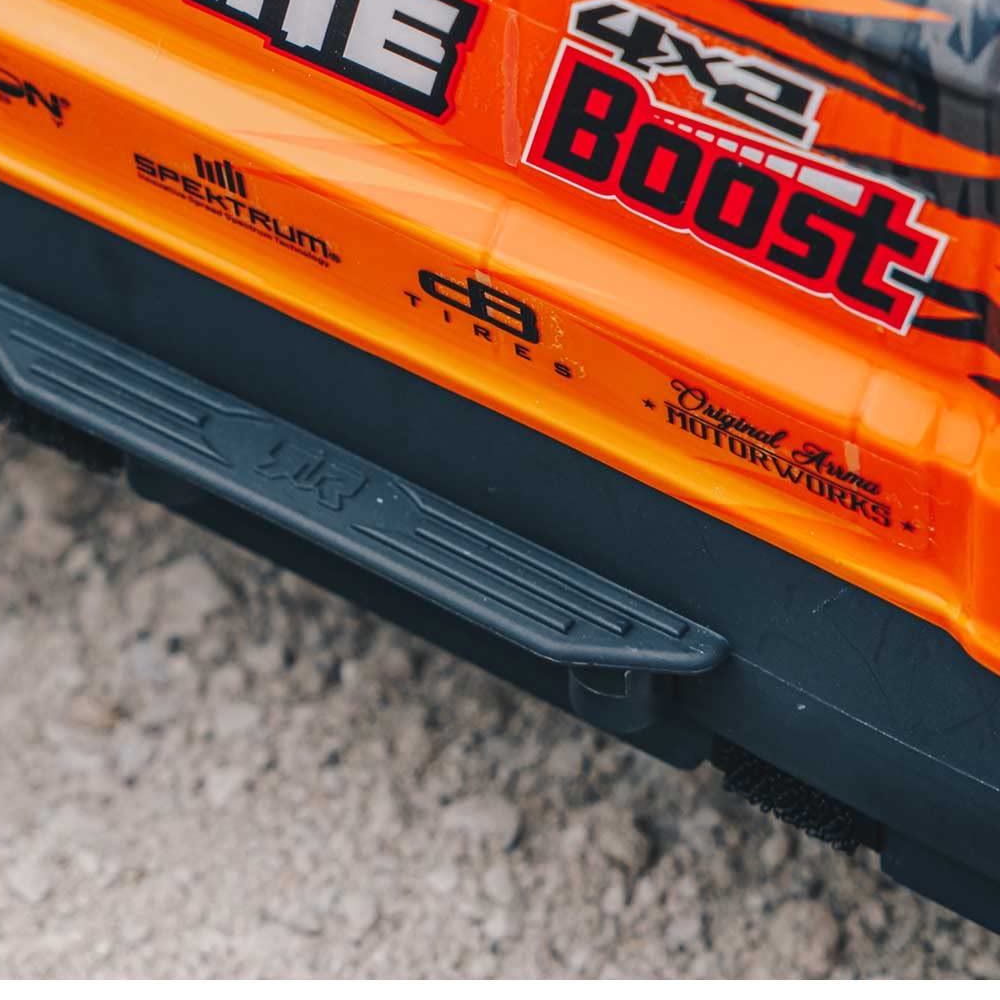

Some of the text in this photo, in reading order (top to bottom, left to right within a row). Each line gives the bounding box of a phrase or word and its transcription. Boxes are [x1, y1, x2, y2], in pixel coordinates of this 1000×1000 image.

[134, 152, 329, 259] SPEKTRUM
[404, 290, 573, 379] TIRES
[665, 404, 892, 528] MOTORWORKS
[670, 379, 881, 496] Original Arrma
